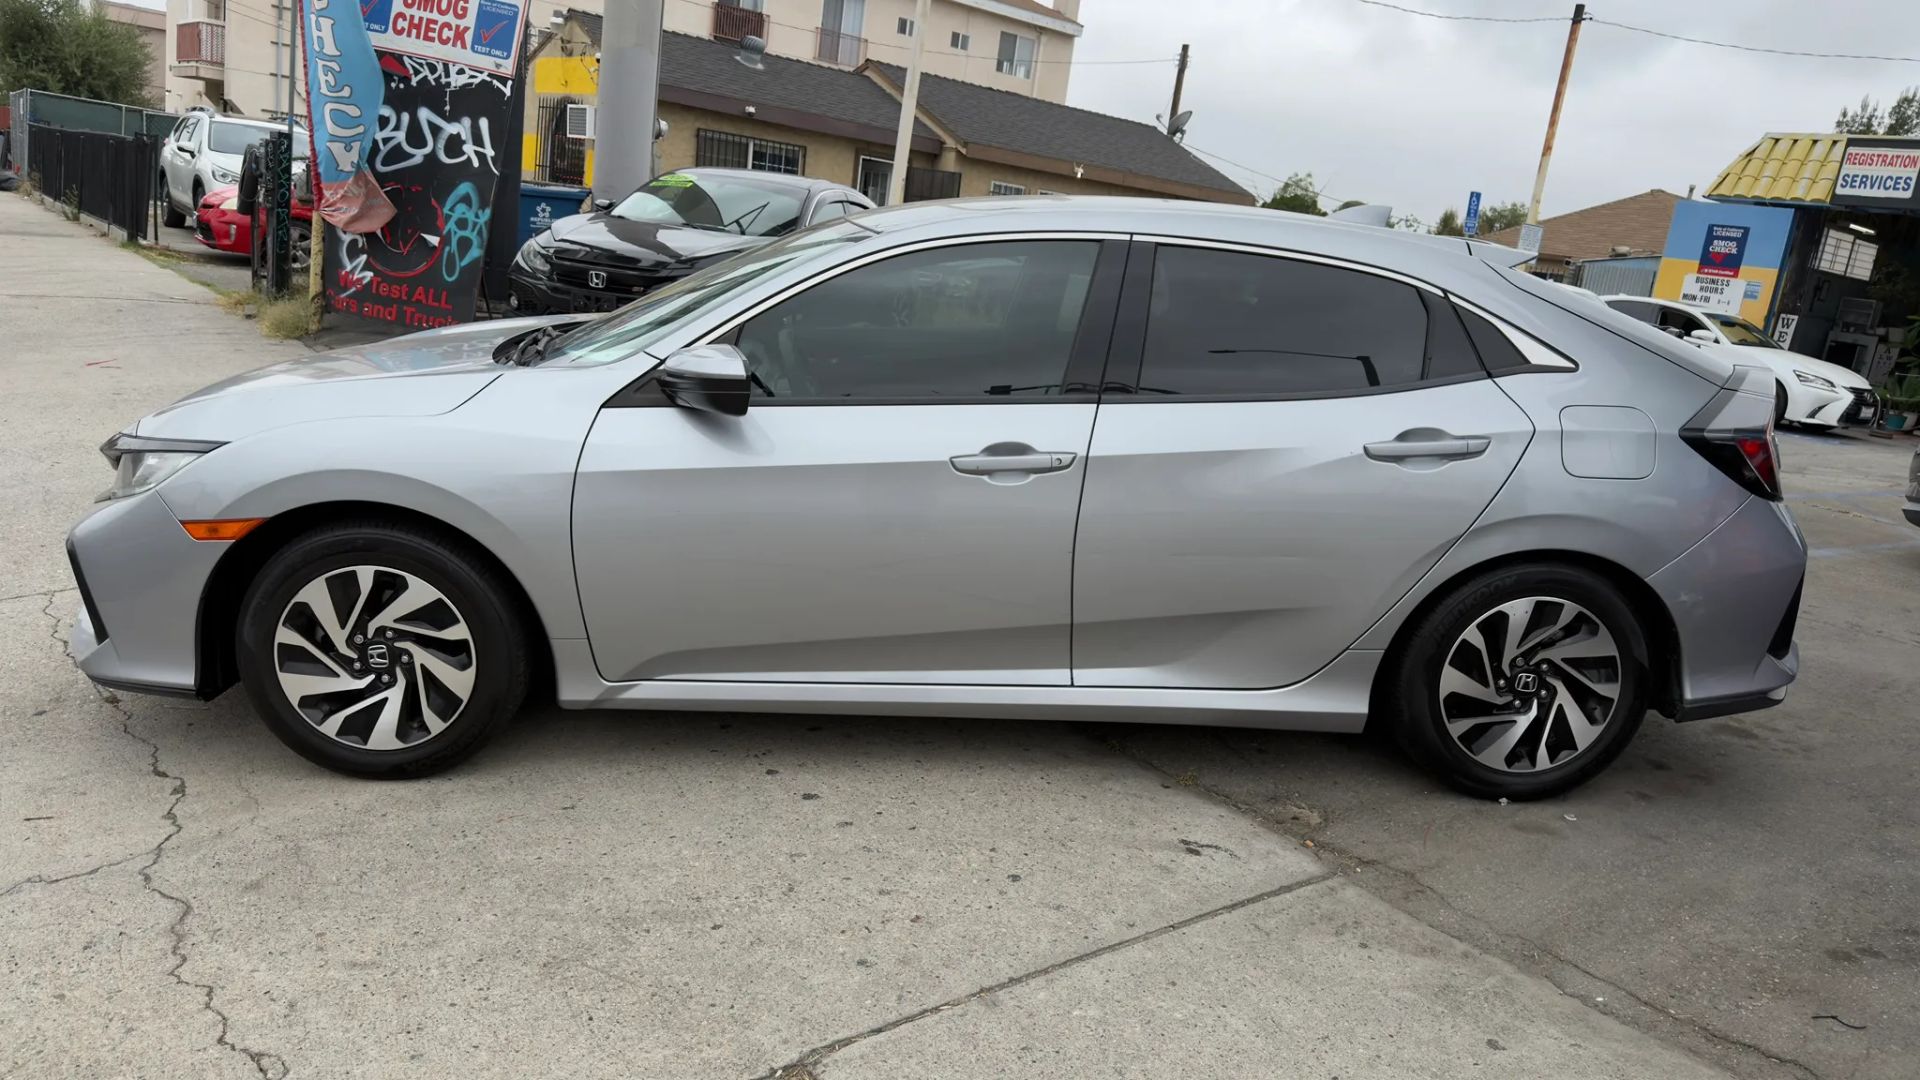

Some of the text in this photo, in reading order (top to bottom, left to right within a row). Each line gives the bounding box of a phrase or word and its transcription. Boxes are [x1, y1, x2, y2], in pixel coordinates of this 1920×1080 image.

[369, 23, 386, 31] ONLY
[392, 11, 471, 50] CHECK
[474, 45, 508, 58] TEST ONLY
[310, 0, 366, 173] HECK
[1845, 152, 1919, 169] REGISTRATION
[1840, 173, 1913, 192] SERVICES
[1713, 230, 1742, 238] LICENSED
[1709, 246, 1738, 254] CHECK
[1713, 240, 1737, 248] SMOG
[1695, 276, 1731, 287] BUSINESS
[371, 276, 410, 300] Test
[412, 286, 453, 310] ALL
[1699, 285, 1725, 295] HOURS
[1682, 293, 1711, 303] MON-FRI
[362, 302, 397, 321] and
